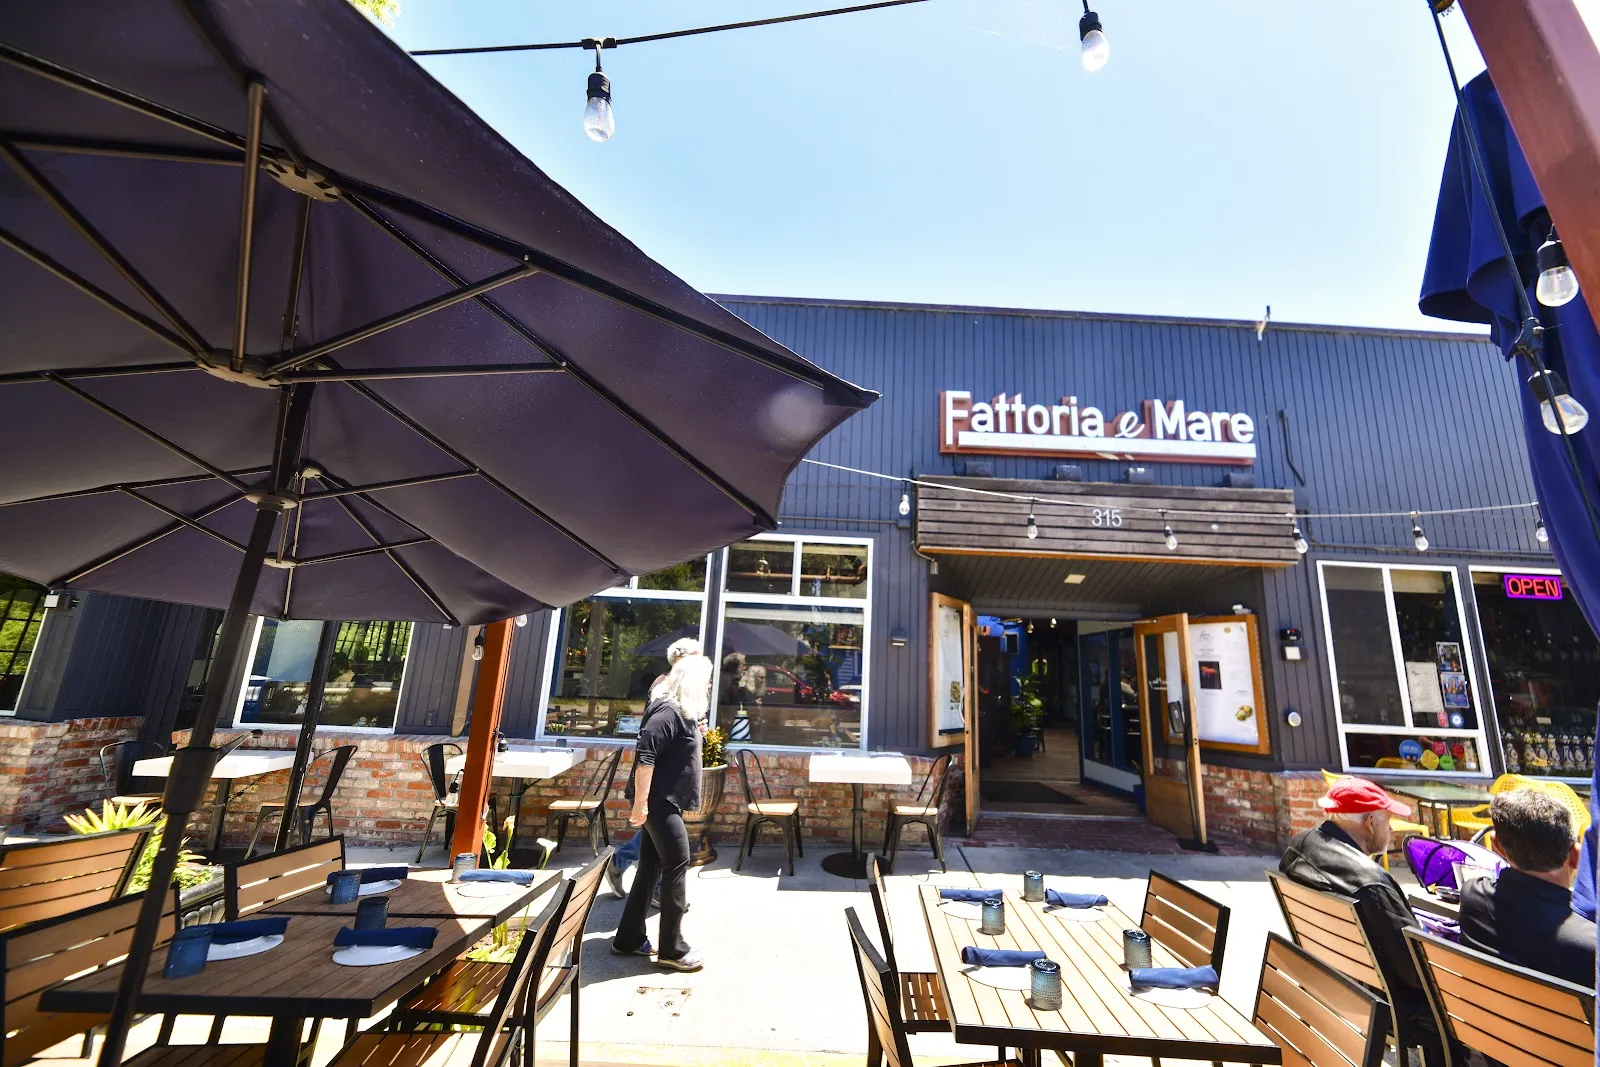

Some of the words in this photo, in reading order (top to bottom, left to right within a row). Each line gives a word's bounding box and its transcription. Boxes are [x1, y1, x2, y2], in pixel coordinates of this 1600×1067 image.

[945, 390, 1104, 445] Fattoria
[1114, 411, 1145, 438] e
[1153, 399, 1254, 443] Mare
[1091, 508, 1122, 527] 315
[1508, 577, 1559, 597] OPEN
